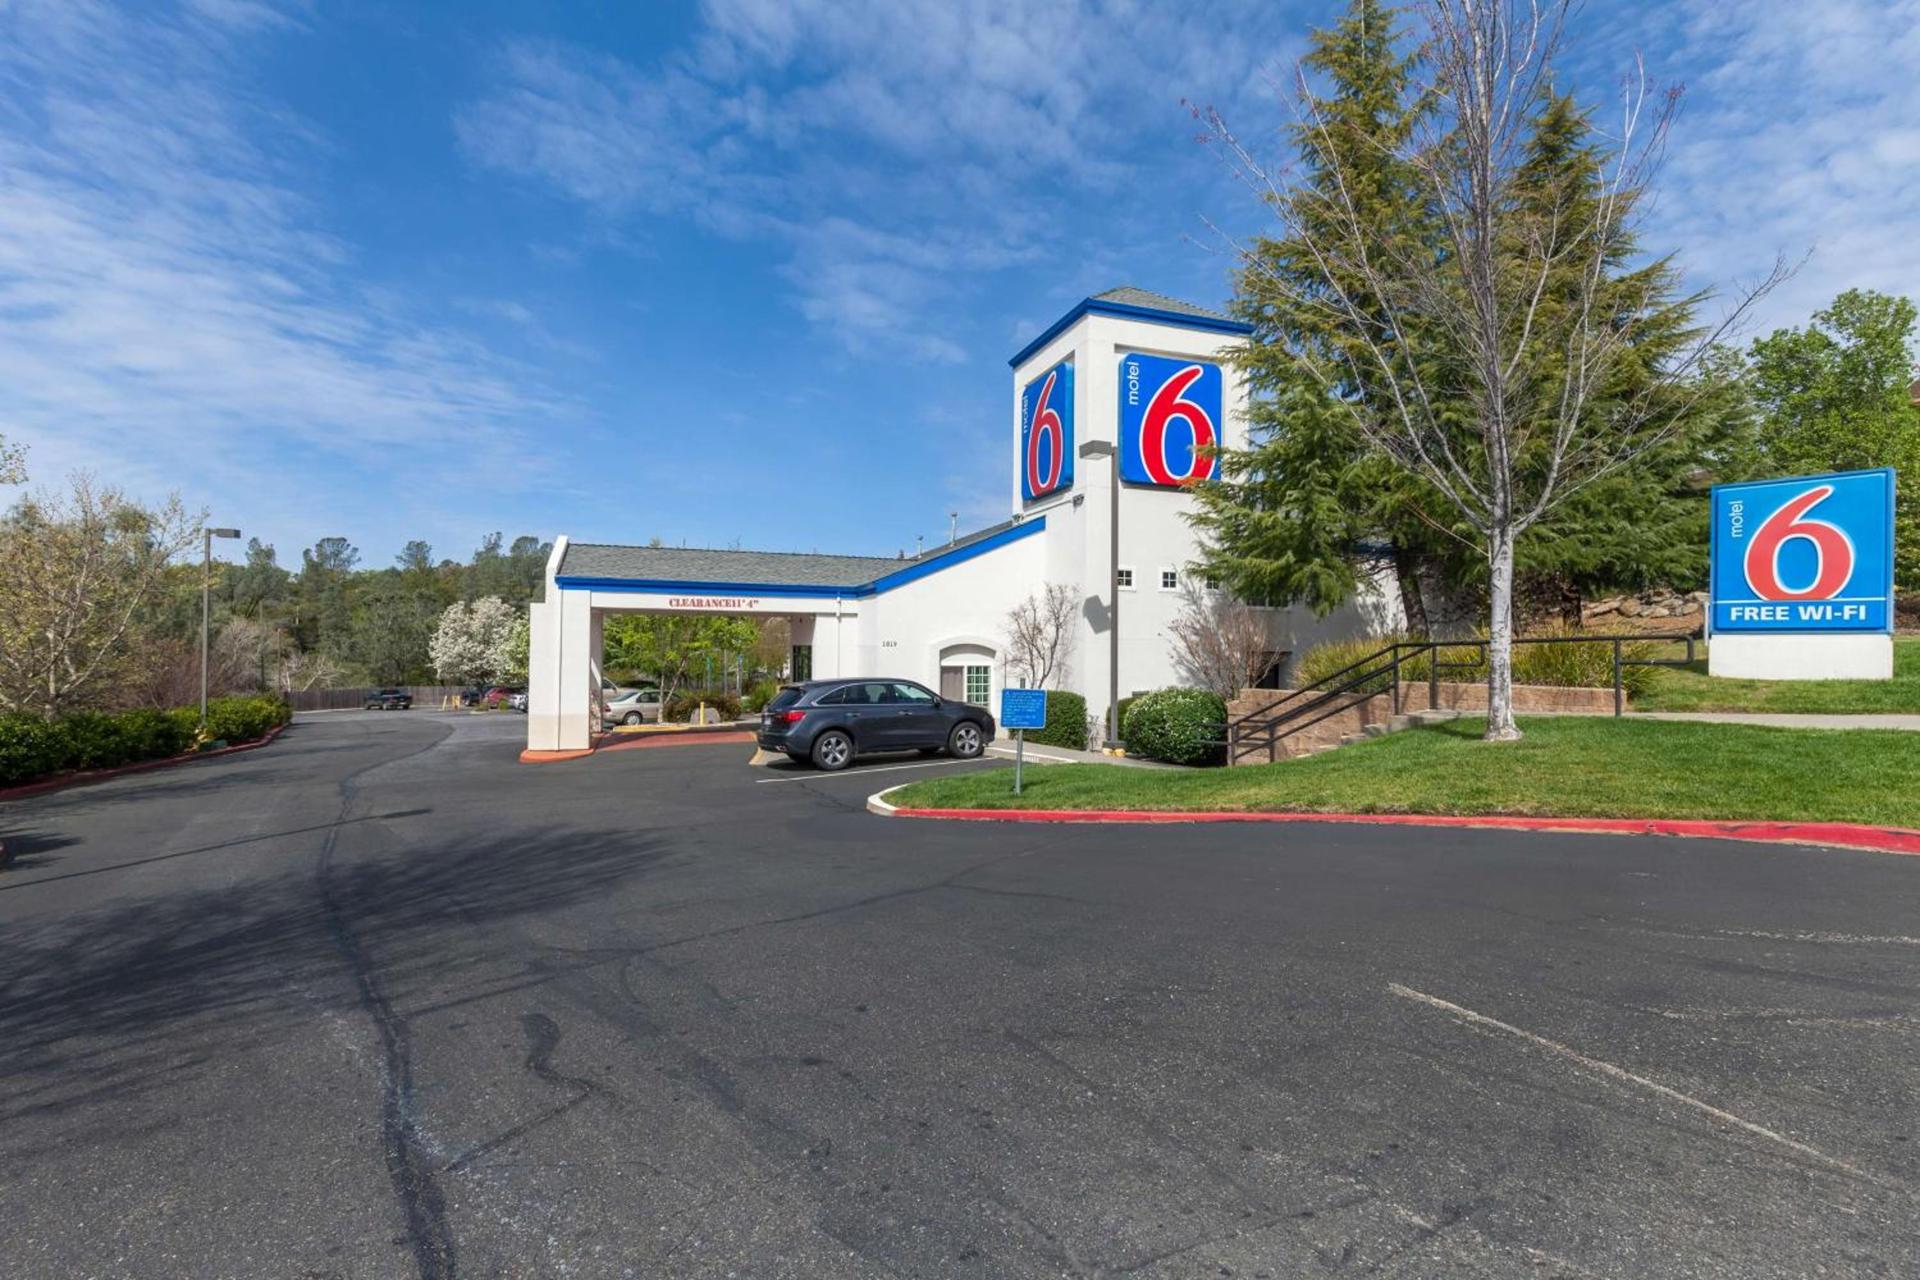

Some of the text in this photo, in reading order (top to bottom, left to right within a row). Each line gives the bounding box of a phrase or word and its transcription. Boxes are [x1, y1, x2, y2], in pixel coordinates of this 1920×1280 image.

[1126, 361, 1140, 405] motel
[1028, 371, 1063, 497] 6
[1139, 365, 1216, 486] 6
[1728, 500, 1744, 538] motel
[1744, 485, 1854, 600] 6
[669, 598, 731, 608] CLEARANCE
[1730, 605, 1866, 621] FREE WI-FI
